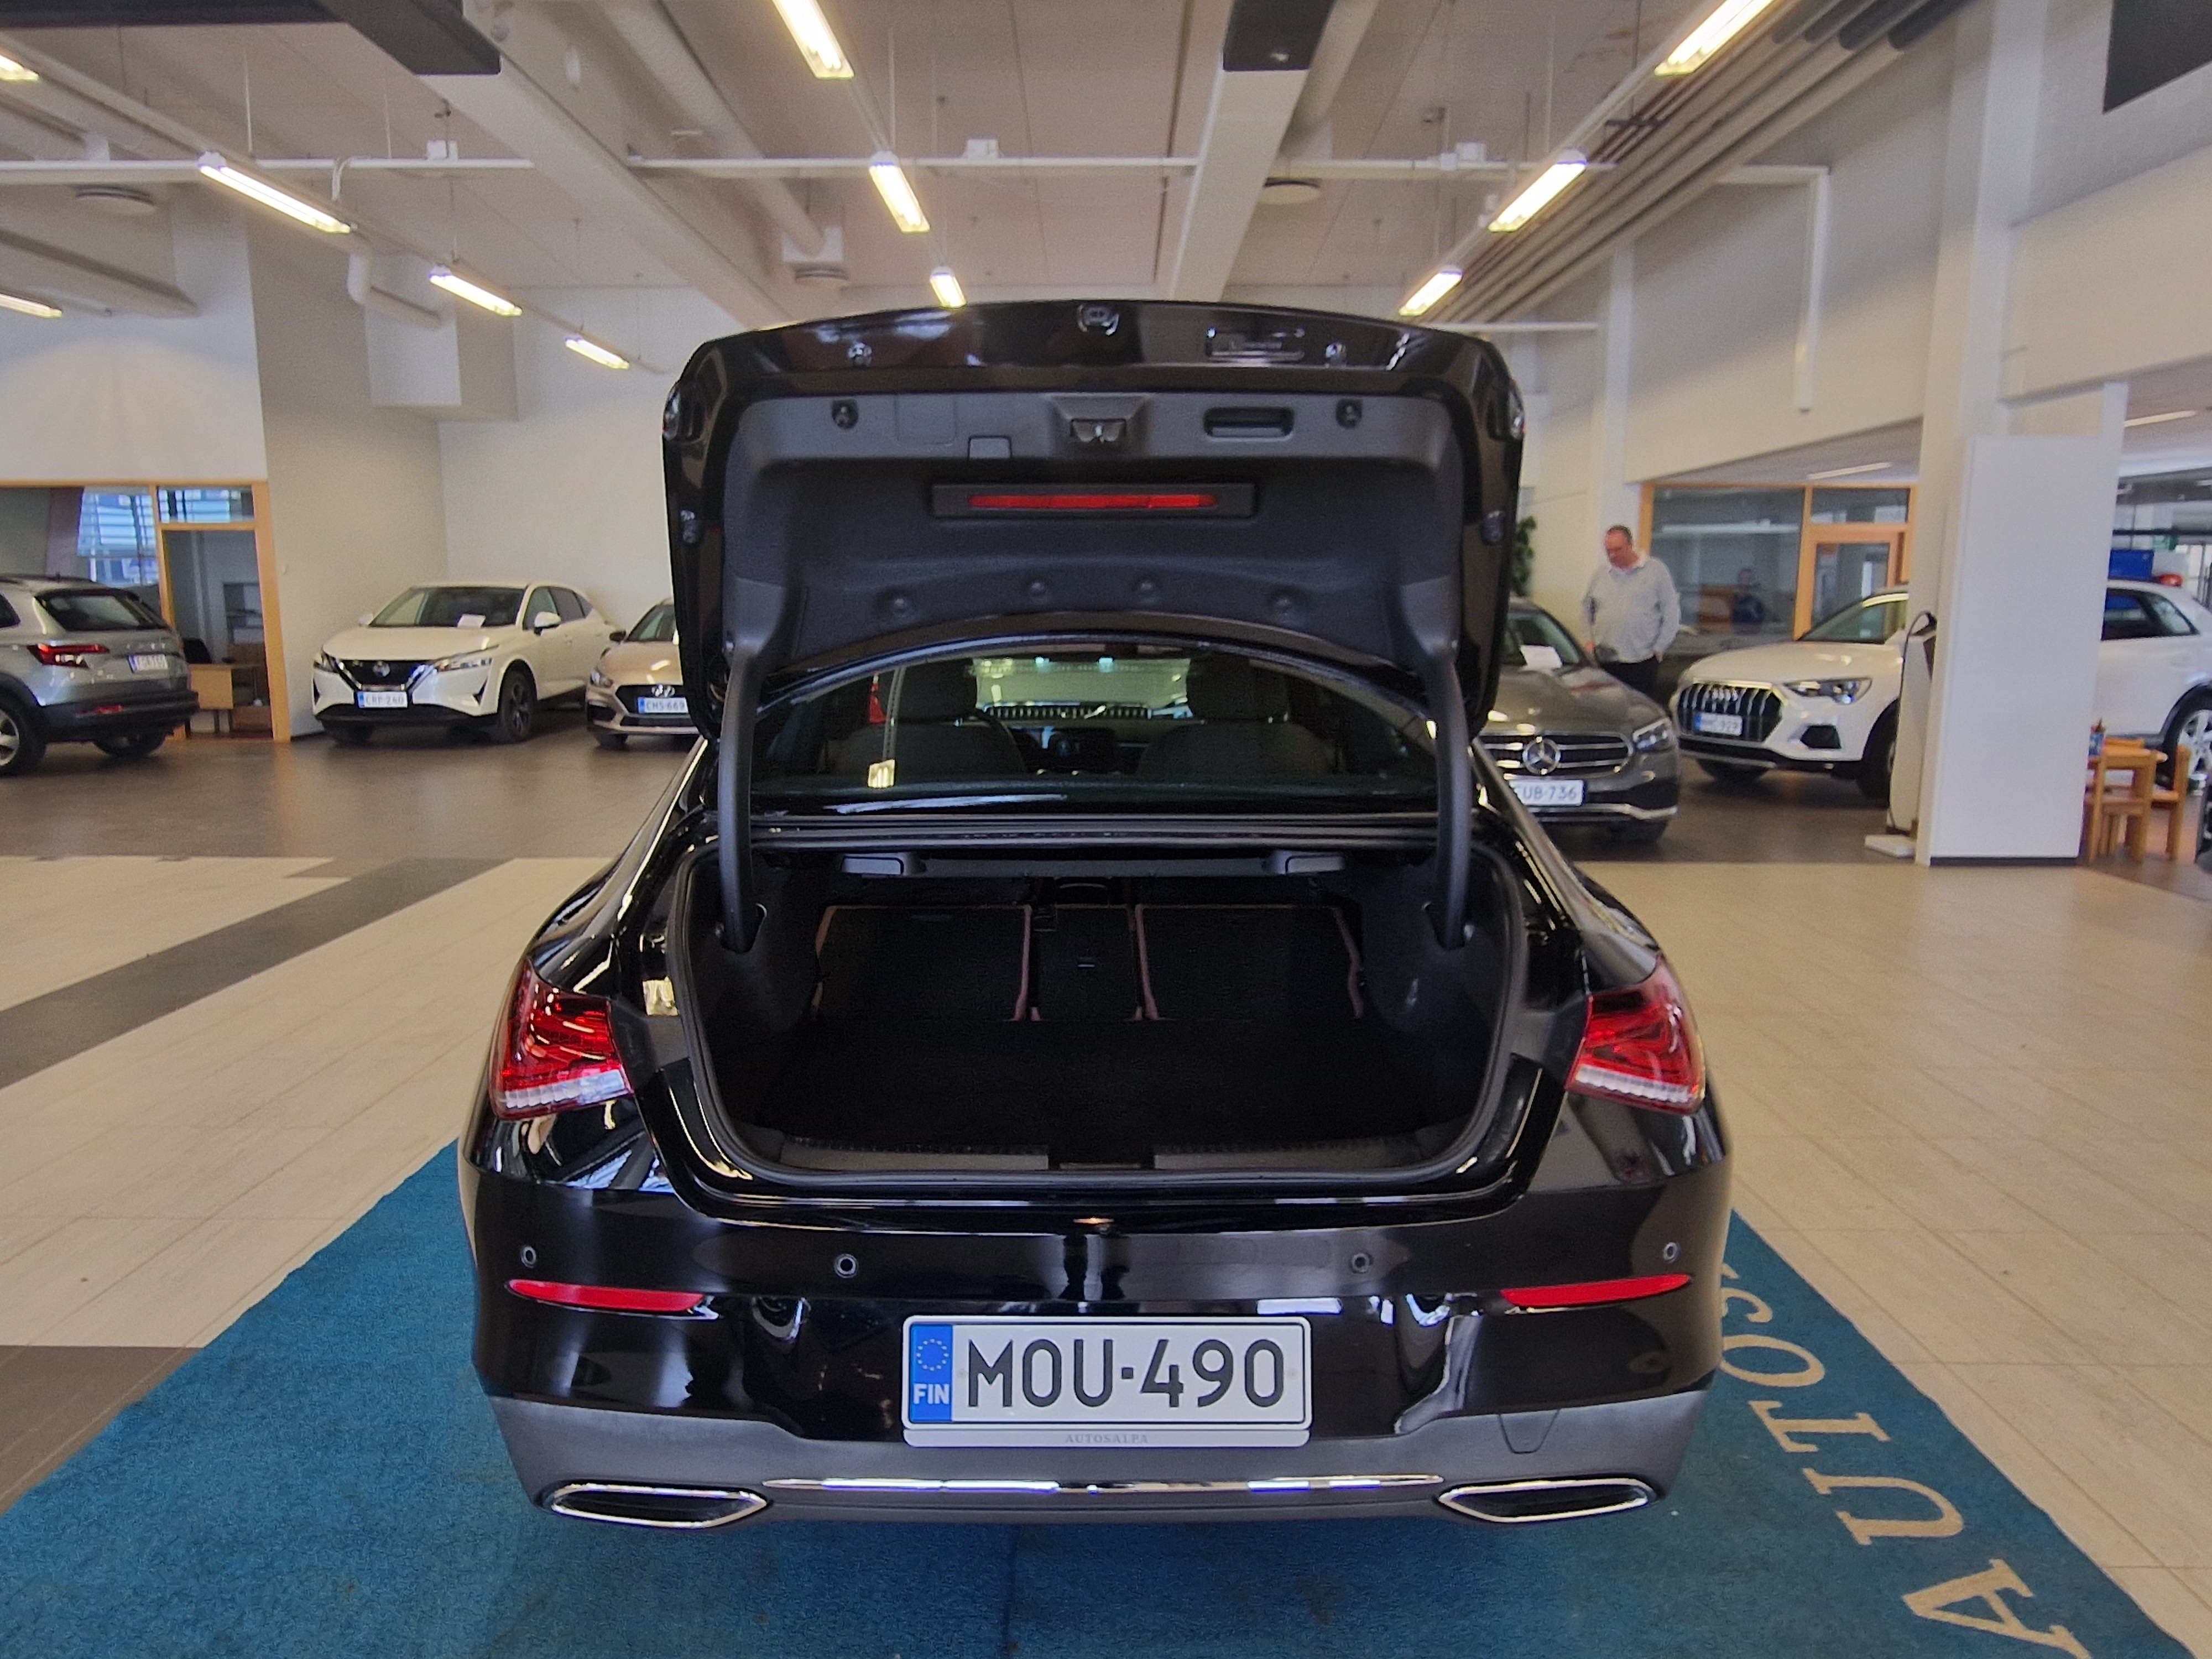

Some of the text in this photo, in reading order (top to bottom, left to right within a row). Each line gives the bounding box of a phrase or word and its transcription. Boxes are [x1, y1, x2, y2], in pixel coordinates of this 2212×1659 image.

[1516, 784, 1577, 800] UB-736
[968, 1338, 1285, 1408] MOU-490
[912, 1383, 950, 1405] FIN
[1065, 1433, 1149, 1444] AUTOSALPA
[1720, 1263, 2091, 1658] AUTOS
